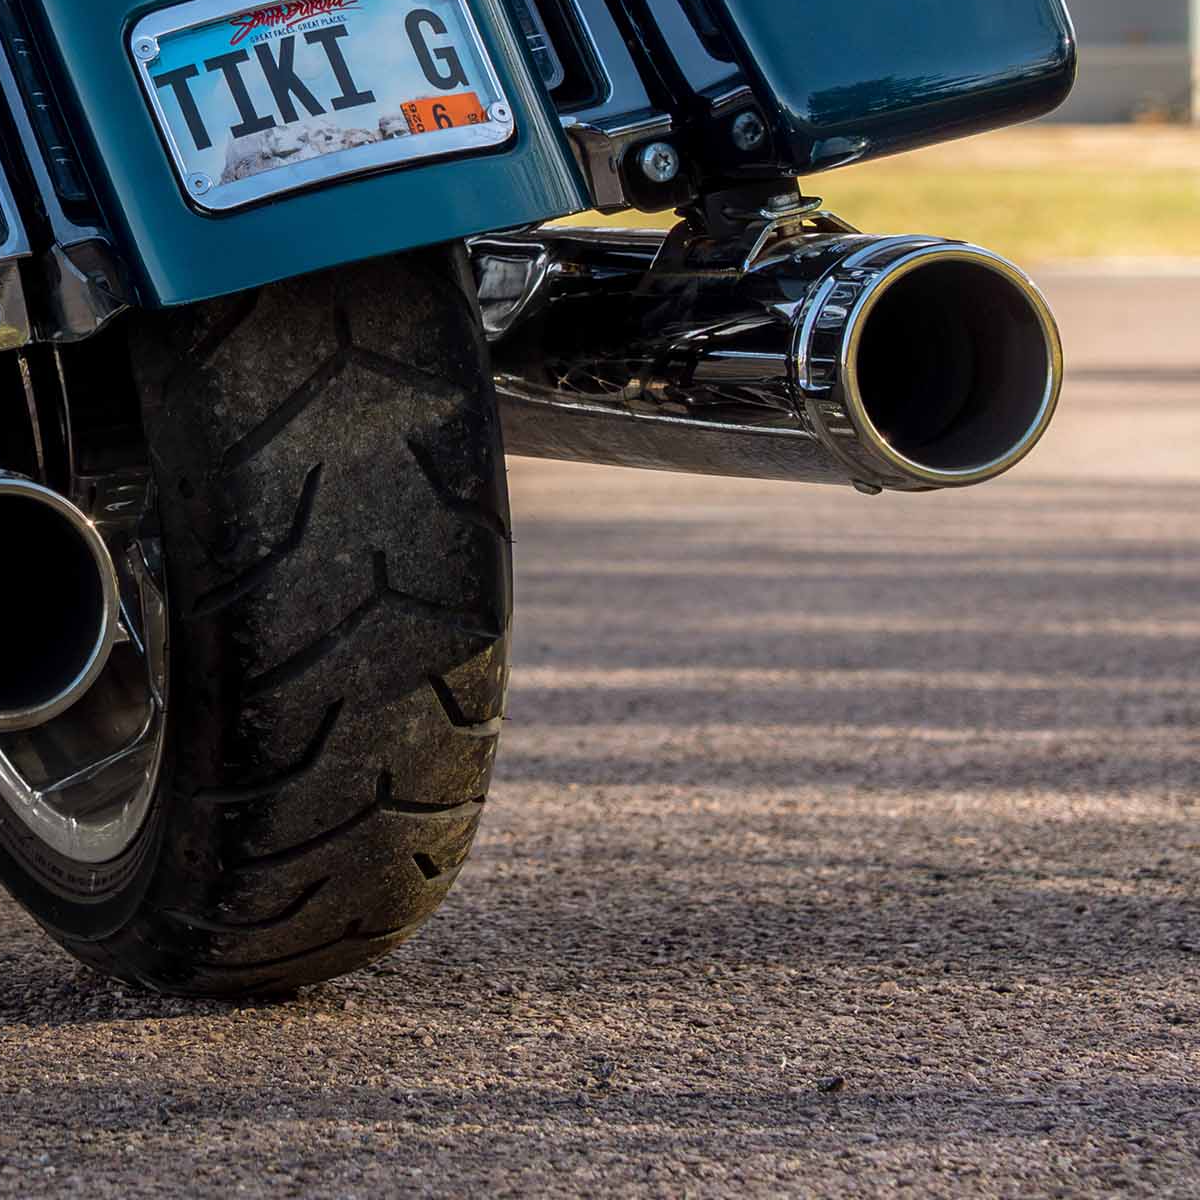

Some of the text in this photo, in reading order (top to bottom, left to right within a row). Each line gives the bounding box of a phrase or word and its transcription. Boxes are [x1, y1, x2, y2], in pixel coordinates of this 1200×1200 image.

[250, 31, 273, 44] GREAT
[298, 21, 321, 32] GREAT
[152, 8, 470, 151] TIKI G
[432, 103, 453, 130] 6
